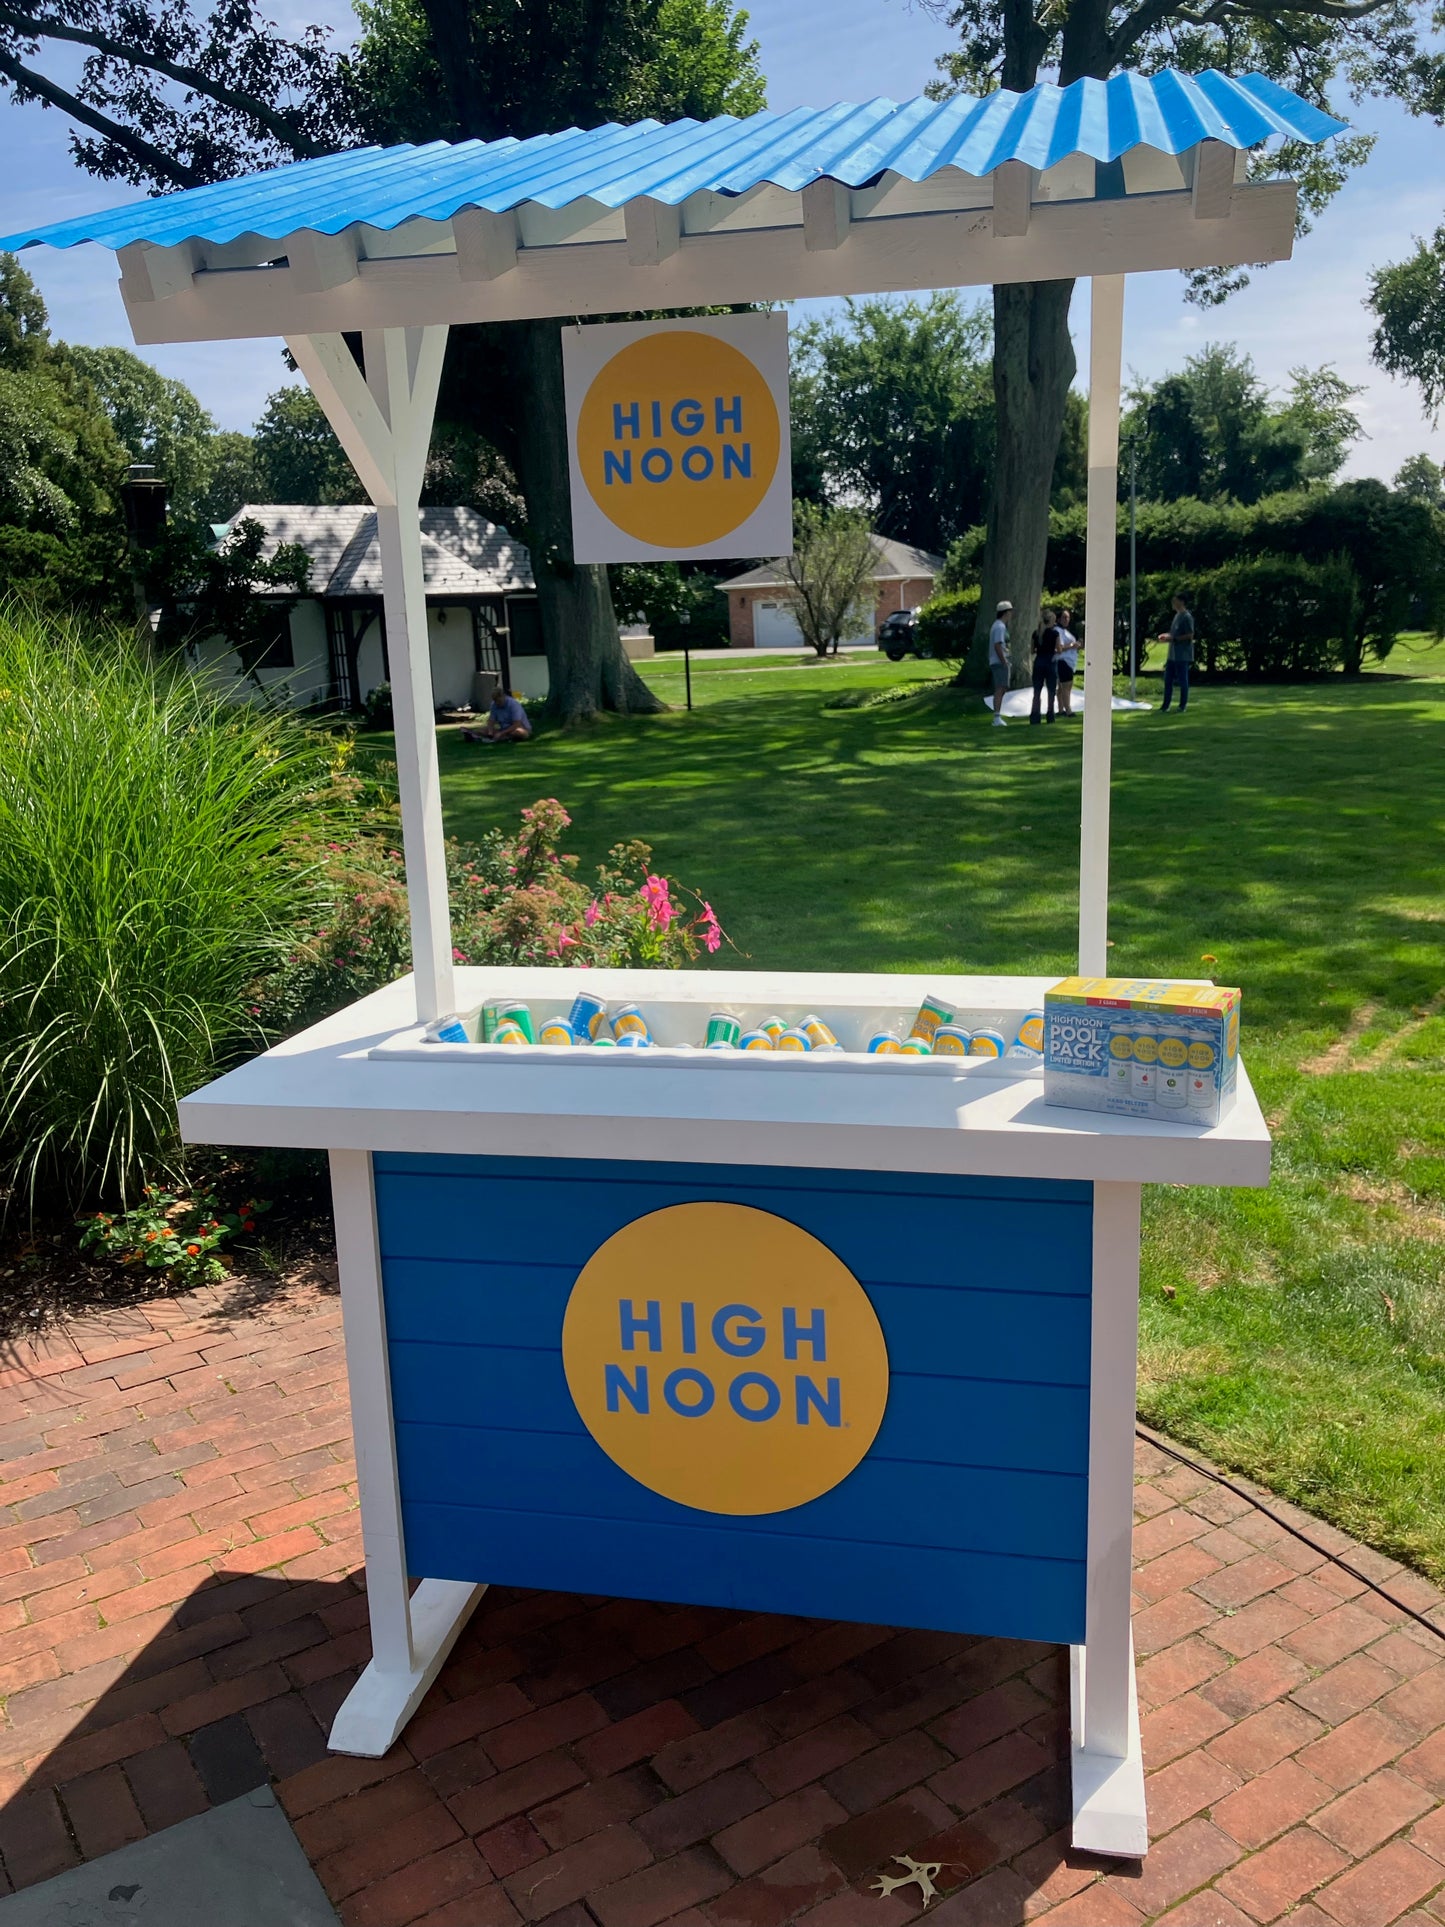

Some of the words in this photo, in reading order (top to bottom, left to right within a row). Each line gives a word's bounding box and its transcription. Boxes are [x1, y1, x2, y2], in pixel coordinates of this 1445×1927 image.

[613, 396, 742, 440] HIGH
[603, 443, 752, 485] NOON
[1051, 1024, 1102, 1044] POOL
[1051, 1040, 1103, 1061] PACK
[619, 1299, 827, 1362] HIGH
[604, 1364, 842, 1428] NOON
